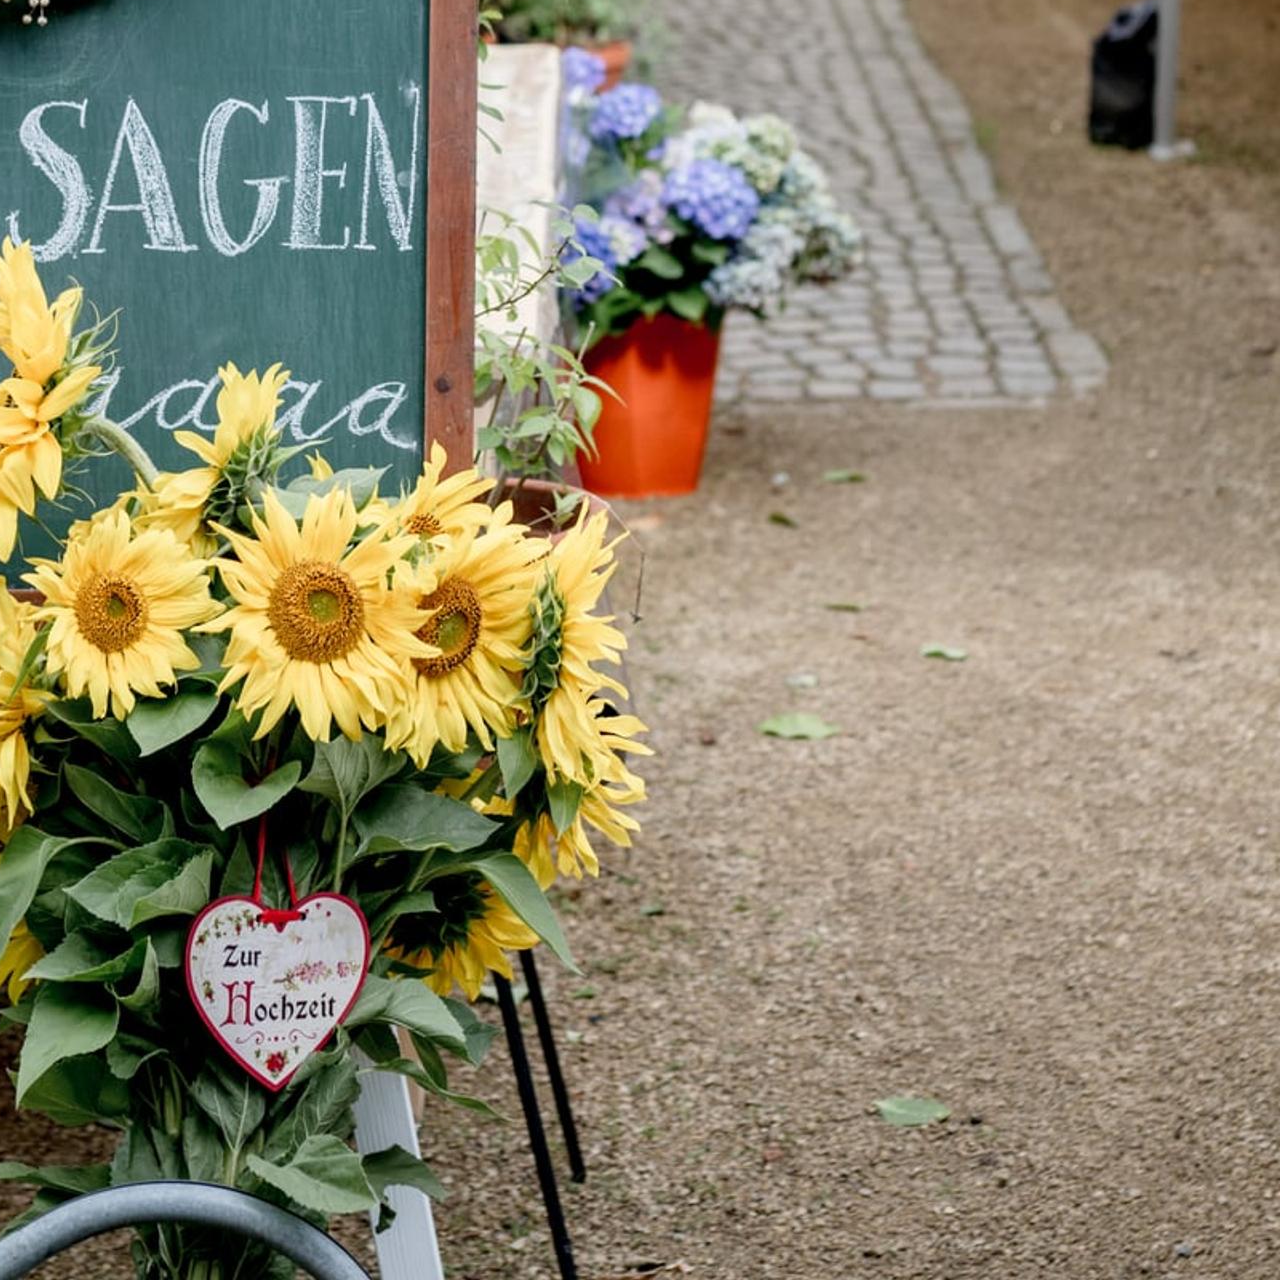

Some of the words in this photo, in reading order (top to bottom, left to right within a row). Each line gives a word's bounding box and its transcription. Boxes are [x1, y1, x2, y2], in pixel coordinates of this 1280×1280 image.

[5, 86, 421, 264] SAGEN
[222, 944, 262, 969] Zur
[220, 980, 337, 1027] Hochzeit
